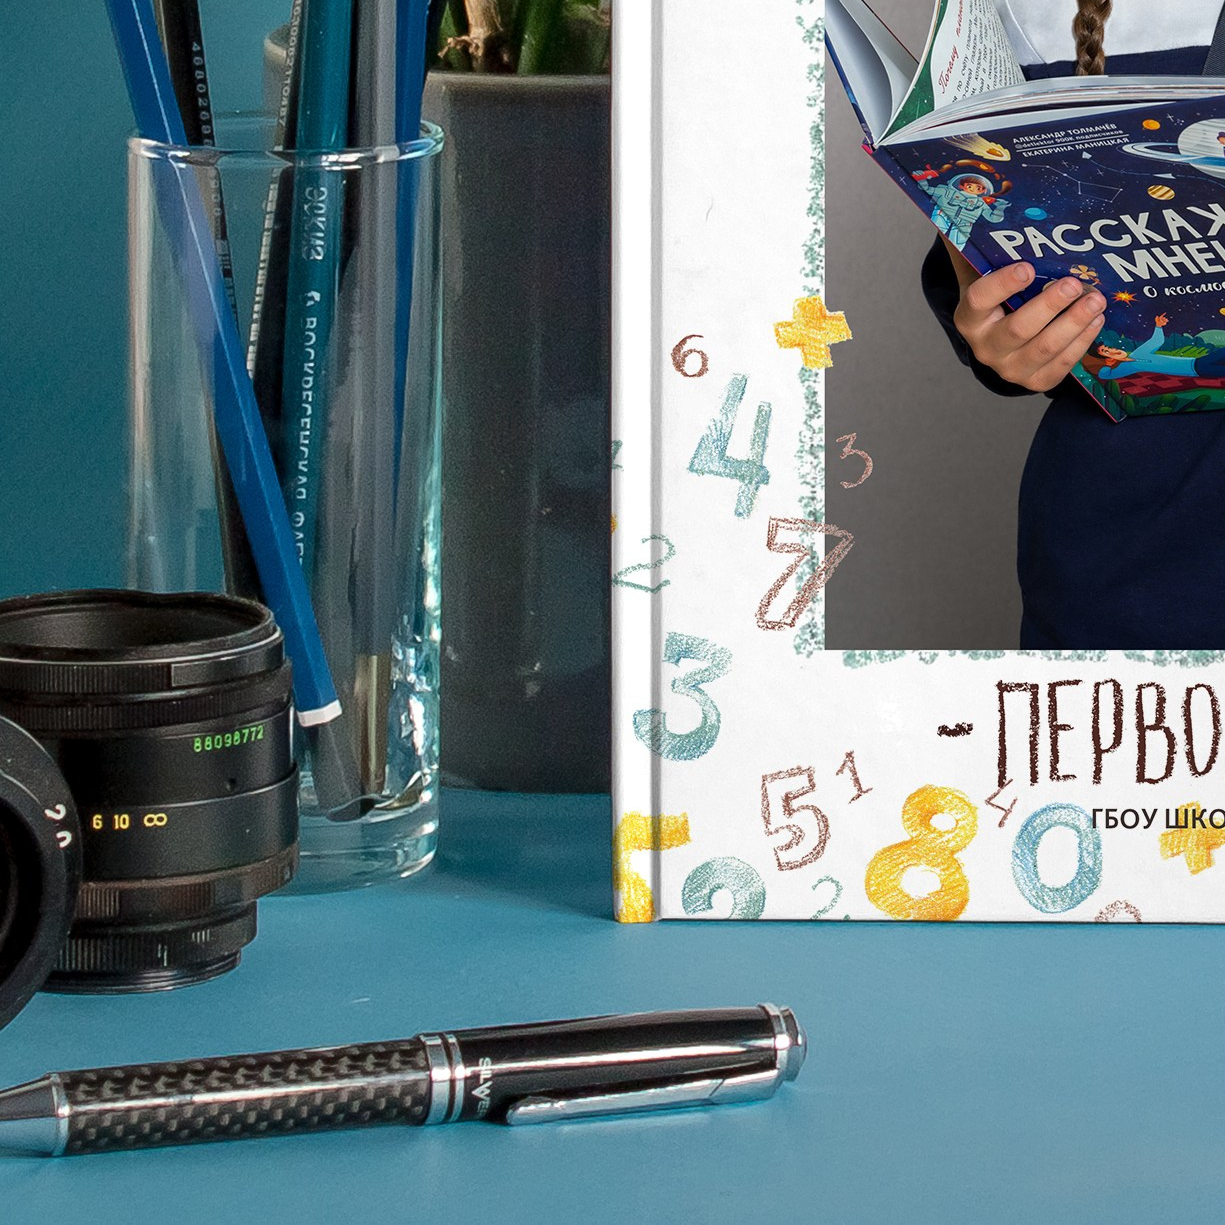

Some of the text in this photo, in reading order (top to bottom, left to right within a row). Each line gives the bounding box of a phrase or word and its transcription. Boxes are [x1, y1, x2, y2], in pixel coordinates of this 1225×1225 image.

[1013, 123, 1117, 144] АЛЕКСАНДР ТОЛМАЧЁВ
[1022, 137, 1130, 158] ЕКАТЕРИНА МАНИЦКАЯ
[686, 372, 772, 519] 4
[632, 631, 733, 761] 3
[193, 725, 264, 753] 88098772
[92, 814, 102, 830] 6
[114, 813, 130, 830] 10
[1091, 808, 1159, 830] ГБОУ
[865, 783, 979, 921] 8
